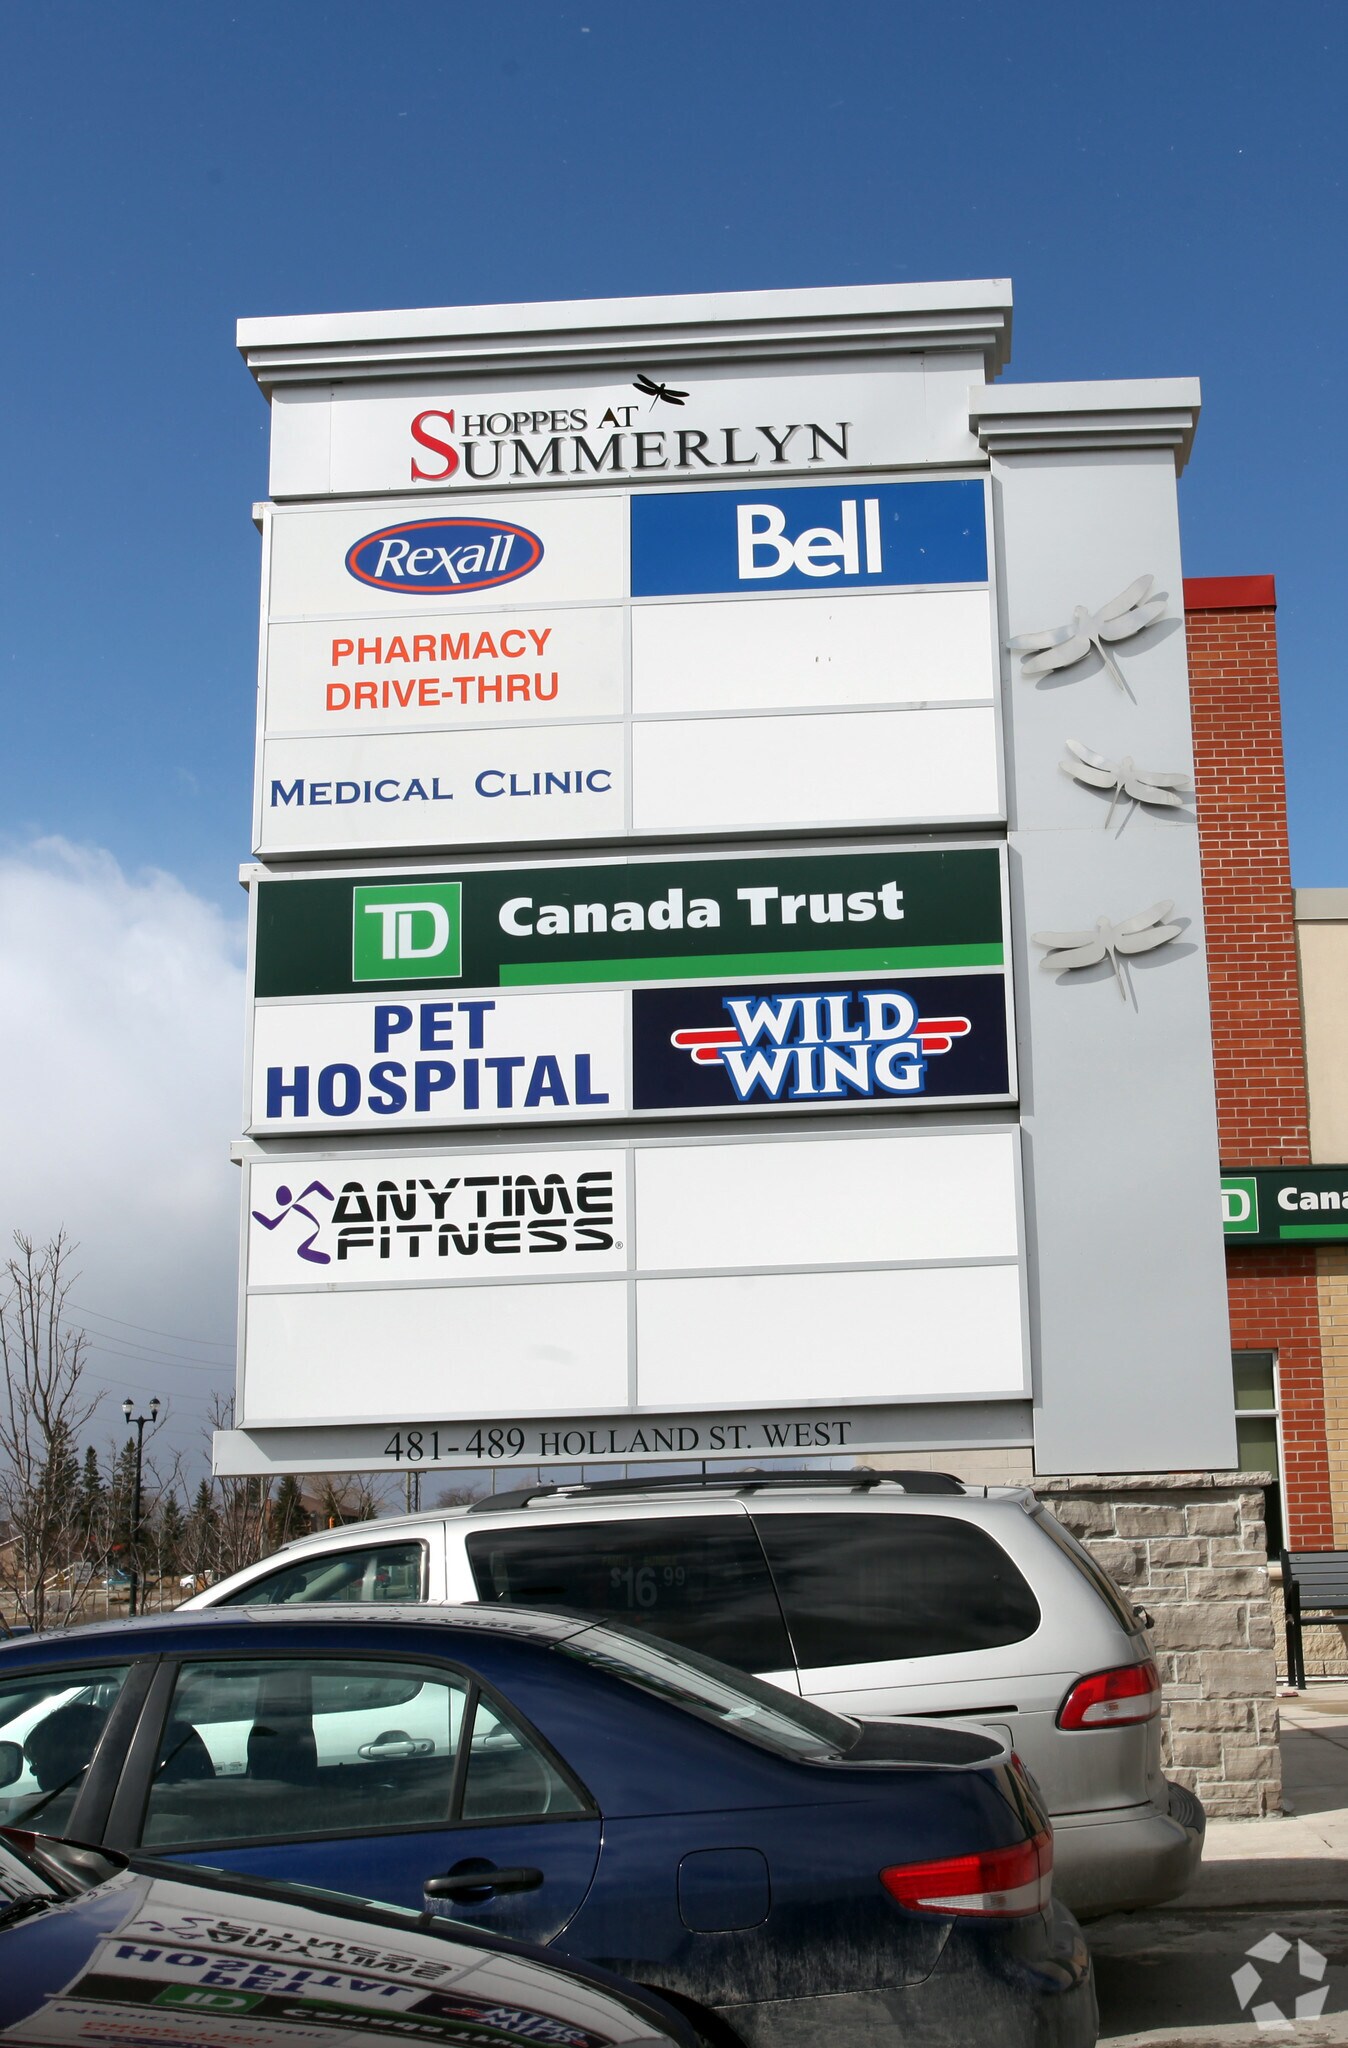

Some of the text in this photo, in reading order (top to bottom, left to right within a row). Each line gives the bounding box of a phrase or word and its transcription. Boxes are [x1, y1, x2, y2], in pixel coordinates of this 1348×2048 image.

[597, 405, 639, 429] AT
[410, 409, 852, 481] SUMMERLYN
[373, 533, 516, 584] Rexall
[736, 498, 883, 581] Bell
[331, 627, 552, 667] PHARMACY
[325, 671, 560, 712] DRIVE-THRU
[270, 769, 612, 807] MEDICAL CLINIC
[364, 901, 450, 960] TD
[498, 880, 905, 937] Canada Trust
[374, 1001, 496, 1053] PET
[724, 990, 917, 1047] WILD
[266, 1055, 610, 1118] HOSPITAL
[720, 1042, 925, 1099] WING
[330, 1170, 614, 1224] ANYTIME
[1220, 1188, 1251, 1222] D
[337, 1216, 615, 1260] FITNESS
[383, 1420, 852, 1462] 481-489 HOLLAND ST. WEST
